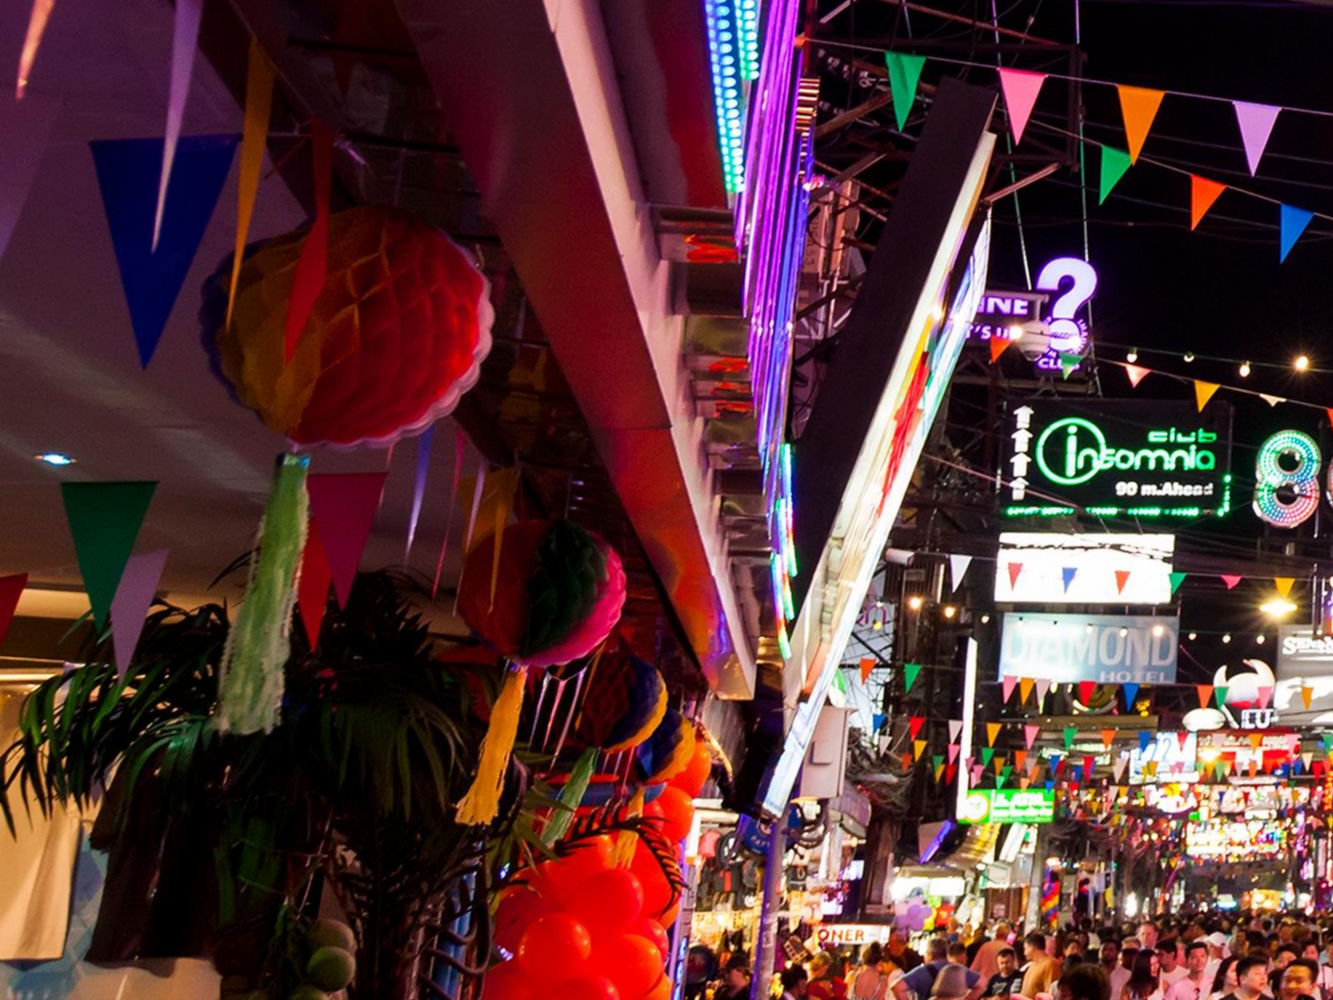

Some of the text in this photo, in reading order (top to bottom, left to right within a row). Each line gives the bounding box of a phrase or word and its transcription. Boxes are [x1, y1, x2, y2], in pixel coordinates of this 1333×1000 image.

[1037, 357, 1080, 370] CLU
[1060, 424, 1216, 479] insomnia
[1115, 481, 1138, 496] 90
[1007, 625, 1177, 666] DIAMOND
[1101, 671, 1174, 683] HOTEL
